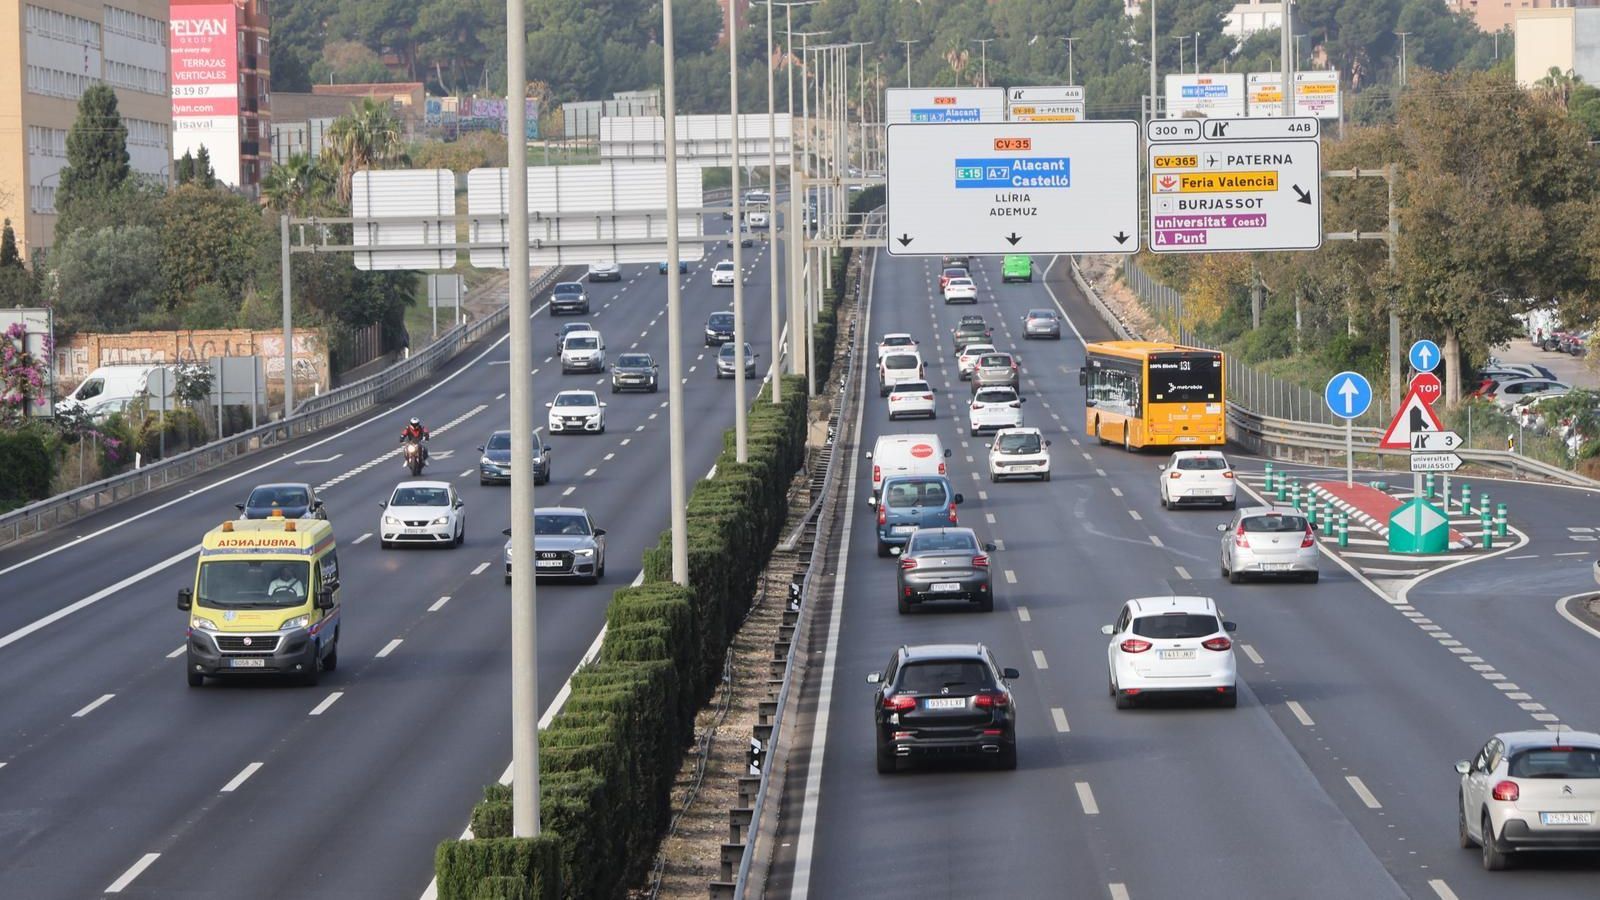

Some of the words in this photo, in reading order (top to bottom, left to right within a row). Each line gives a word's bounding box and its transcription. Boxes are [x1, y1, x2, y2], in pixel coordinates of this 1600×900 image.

[182, 58, 226, 67] TERRAZAS
[175, 71, 227, 80] VERTICALES
[184, 87, 195, 95] 19
[197, 86, 210, 95] 87
[946, 108, 978, 116] Alacant
[1155, 126, 1178, 135] 300
[1288, 123, 1311, 132] 4AB
[996, 140, 1029, 149] CV-35
[1012, 159, 1065, 171] Alacant
[1155, 157, 1196, 167] CV-365
[1227, 154, 1293, 165] PATERNA
[957, 169, 981, 178] E-15
[989, 169, 1007, 178] A-7
[1012, 175, 1068, 186] Castelló
[1182, 177, 1214, 188] Feria
[1218, 175, 1274, 187] Valencia
[995, 192, 1031, 202] LLÍRIA
[1178, 198, 1264, 210] BURJASSOT
[990, 207, 1038, 216] ADEMUZ
[1156, 216, 1227, 228] universitat
[1232, 216, 1265, 228] (oest)
[1157, 231, 1167, 243] À
[1174, 232, 1205, 243] Punt
[1180, 361, 1190, 370] 131
[1419, 384, 1439, 393] TOP
[1445, 436, 1453, 446] 3
